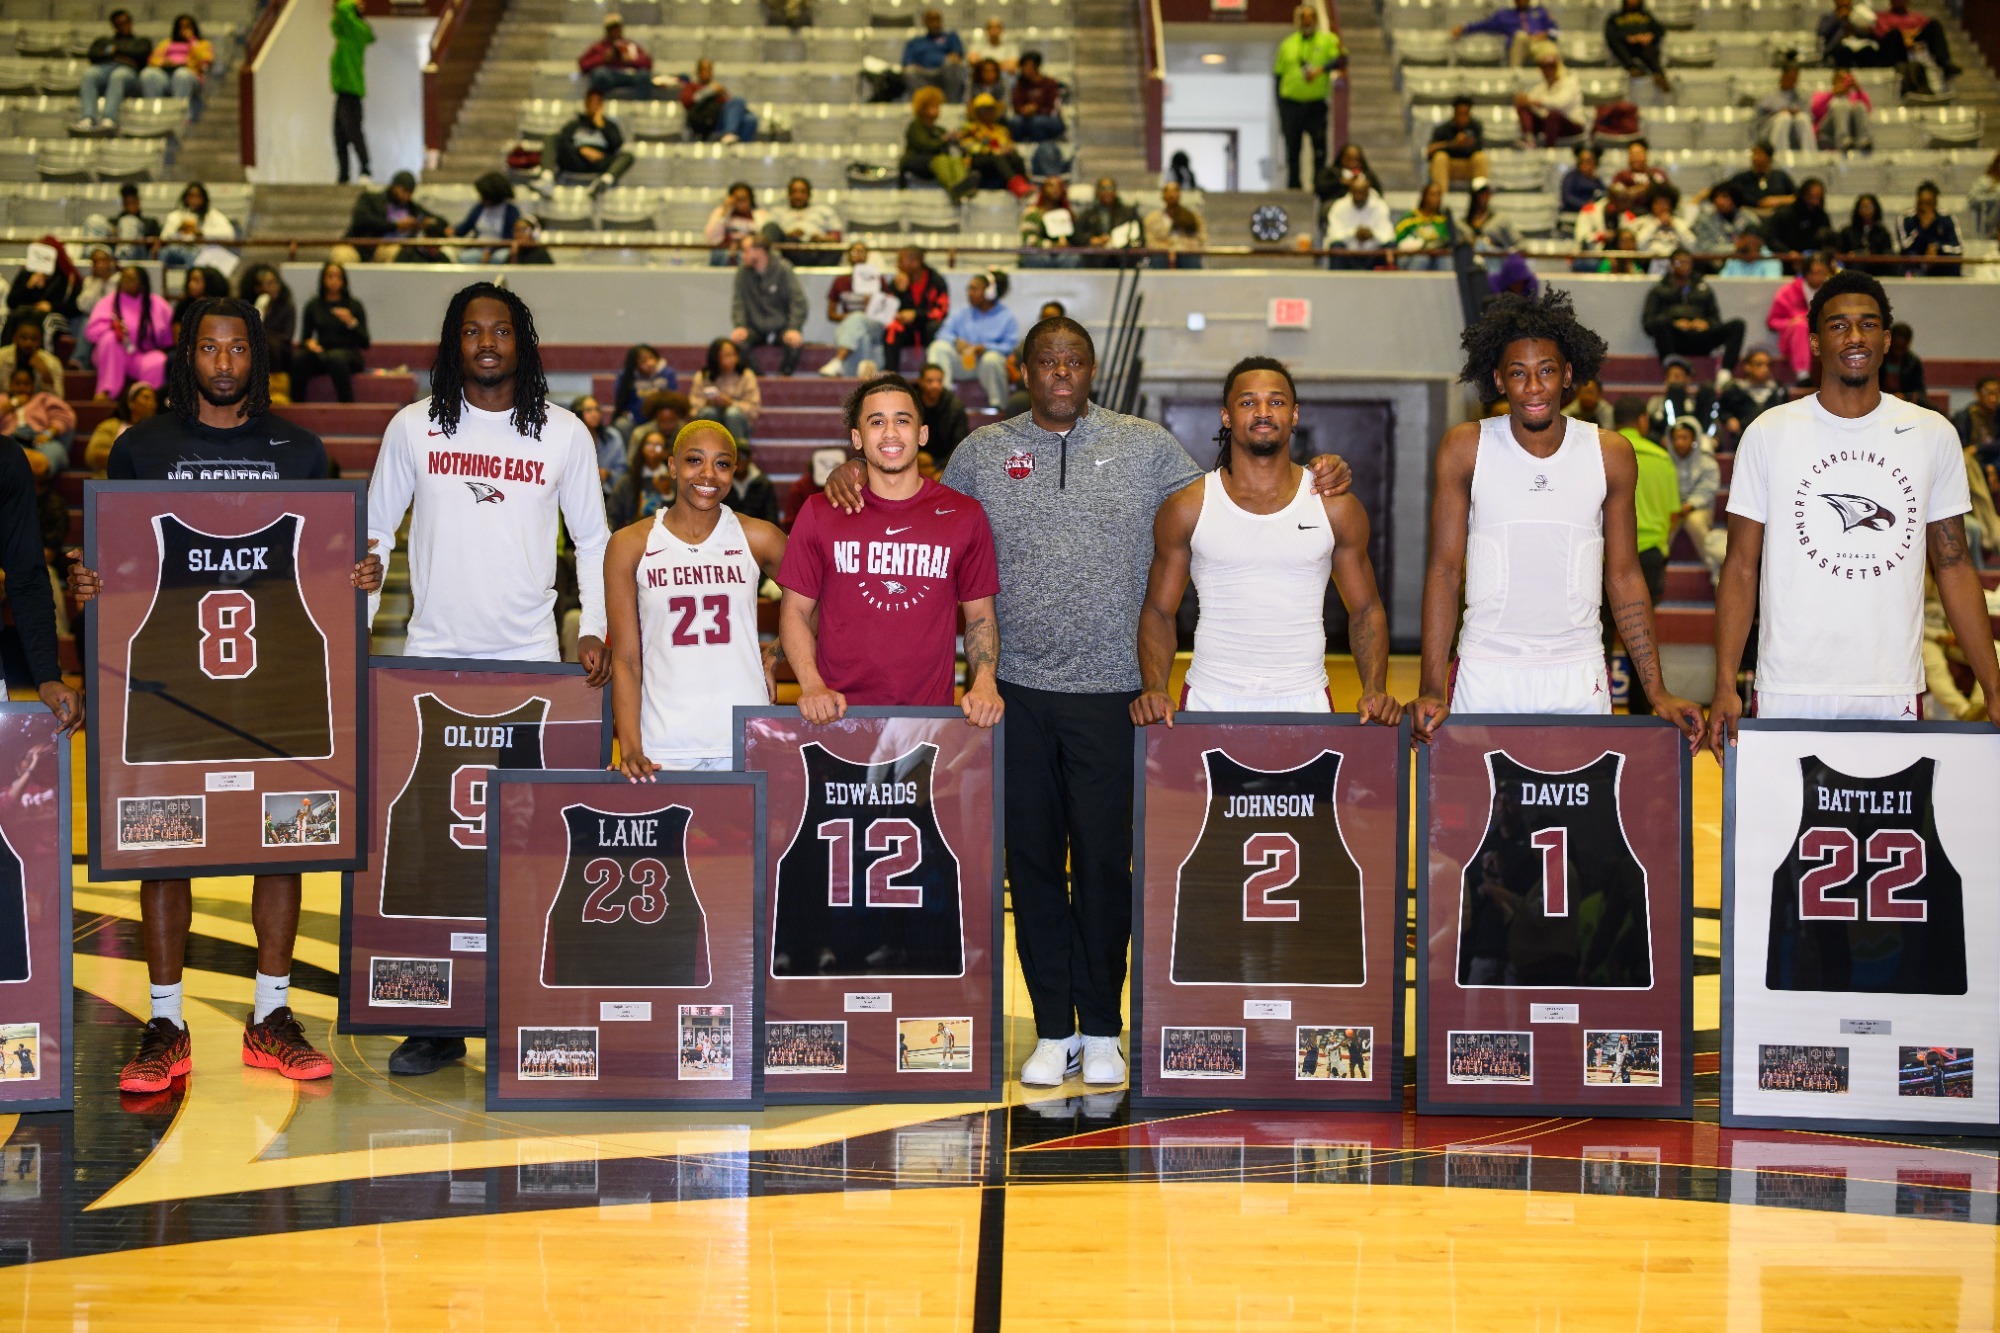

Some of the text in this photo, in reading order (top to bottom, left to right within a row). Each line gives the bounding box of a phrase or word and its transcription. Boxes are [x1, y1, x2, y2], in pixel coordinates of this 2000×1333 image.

[428, 451, 546, 486] NOTHING EASY.
[1794, 450, 1917, 533] NORTH CAROLINA CENTRAL
[188, 547, 269, 572] SLACK
[833, 541, 951, 579] NC CENTRAL
[1798, 535, 1911, 580] BASKETBALL
[647, 565, 746, 588] NC CENTRAL
[859, 581, 930, 611] BASKETBALL
[198, 589, 258, 680] 8
[667, 593, 732, 649] 23
[444, 726, 514, 749] OLUBI
[825, 781, 917, 806] EDWARDS
[1224, 794, 1315, 818] JOHNSON
[1521, 783, 1590, 807] DAVIS
[1817, 786, 1912, 815] BATTLE II
[598, 818, 659, 847] LANE
[817, 818, 924, 908] 12
[1242, 832, 1300, 922] 2
[1530, 826, 1568, 917] 1
[1798, 826, 1928, 923] 22
[582, 857, 671, 924] 23
